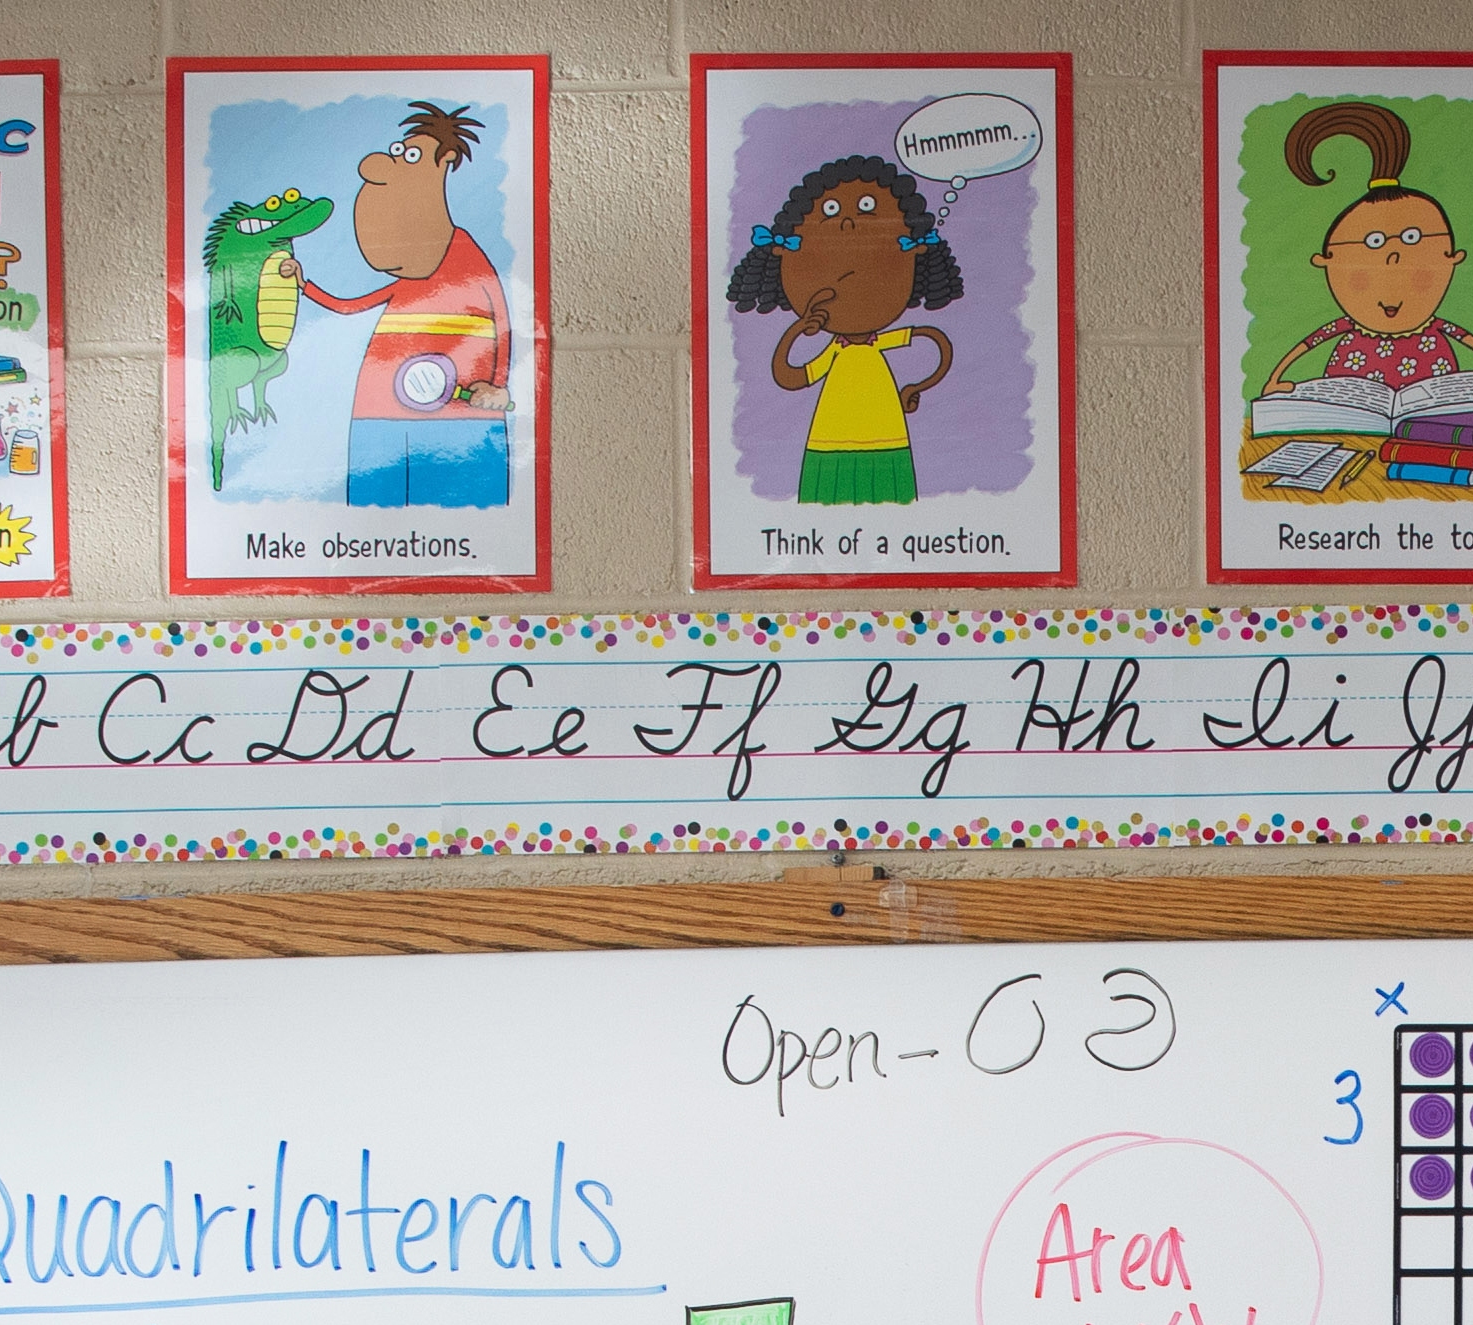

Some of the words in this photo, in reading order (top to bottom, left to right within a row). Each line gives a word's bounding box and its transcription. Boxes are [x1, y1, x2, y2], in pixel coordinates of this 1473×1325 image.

[247, 534, 305, 559] Make
[322, 532, 477, 559] observations.
[761, 529, 825, 556] Think
[838, 530, 861, 555] of
[876, 535, 889, 554] a
[904, 528, 1011, 561] question.
[1279, 523, 1381, 552] Research
[1397, 525, 1434, 552] the
[1036, 1203, 1191, 1301] Area
